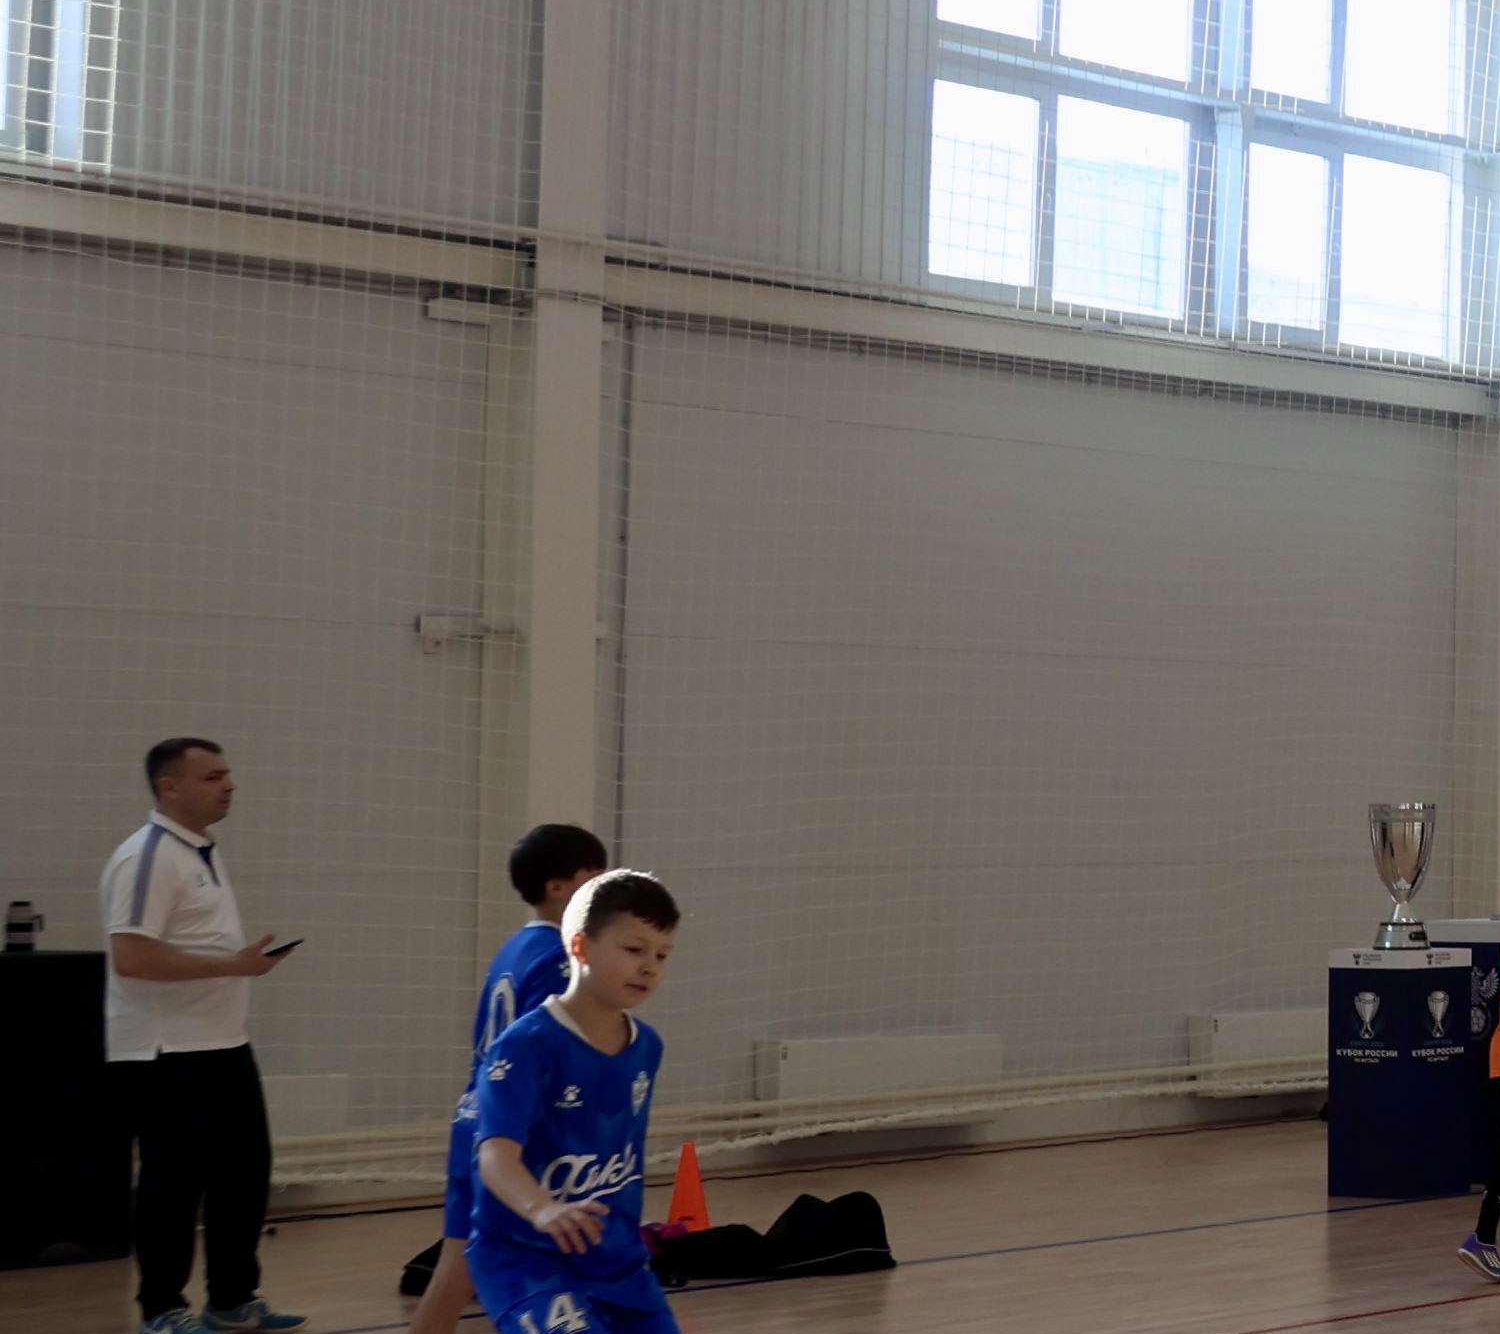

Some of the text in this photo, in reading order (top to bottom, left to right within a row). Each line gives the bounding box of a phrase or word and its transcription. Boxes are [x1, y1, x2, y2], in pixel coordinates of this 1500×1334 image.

[1336, 1047, 1398, 1059] КУБОК РОССИИ
[1411, 1045, 1465, 1058] КУБОК РОССИИ
